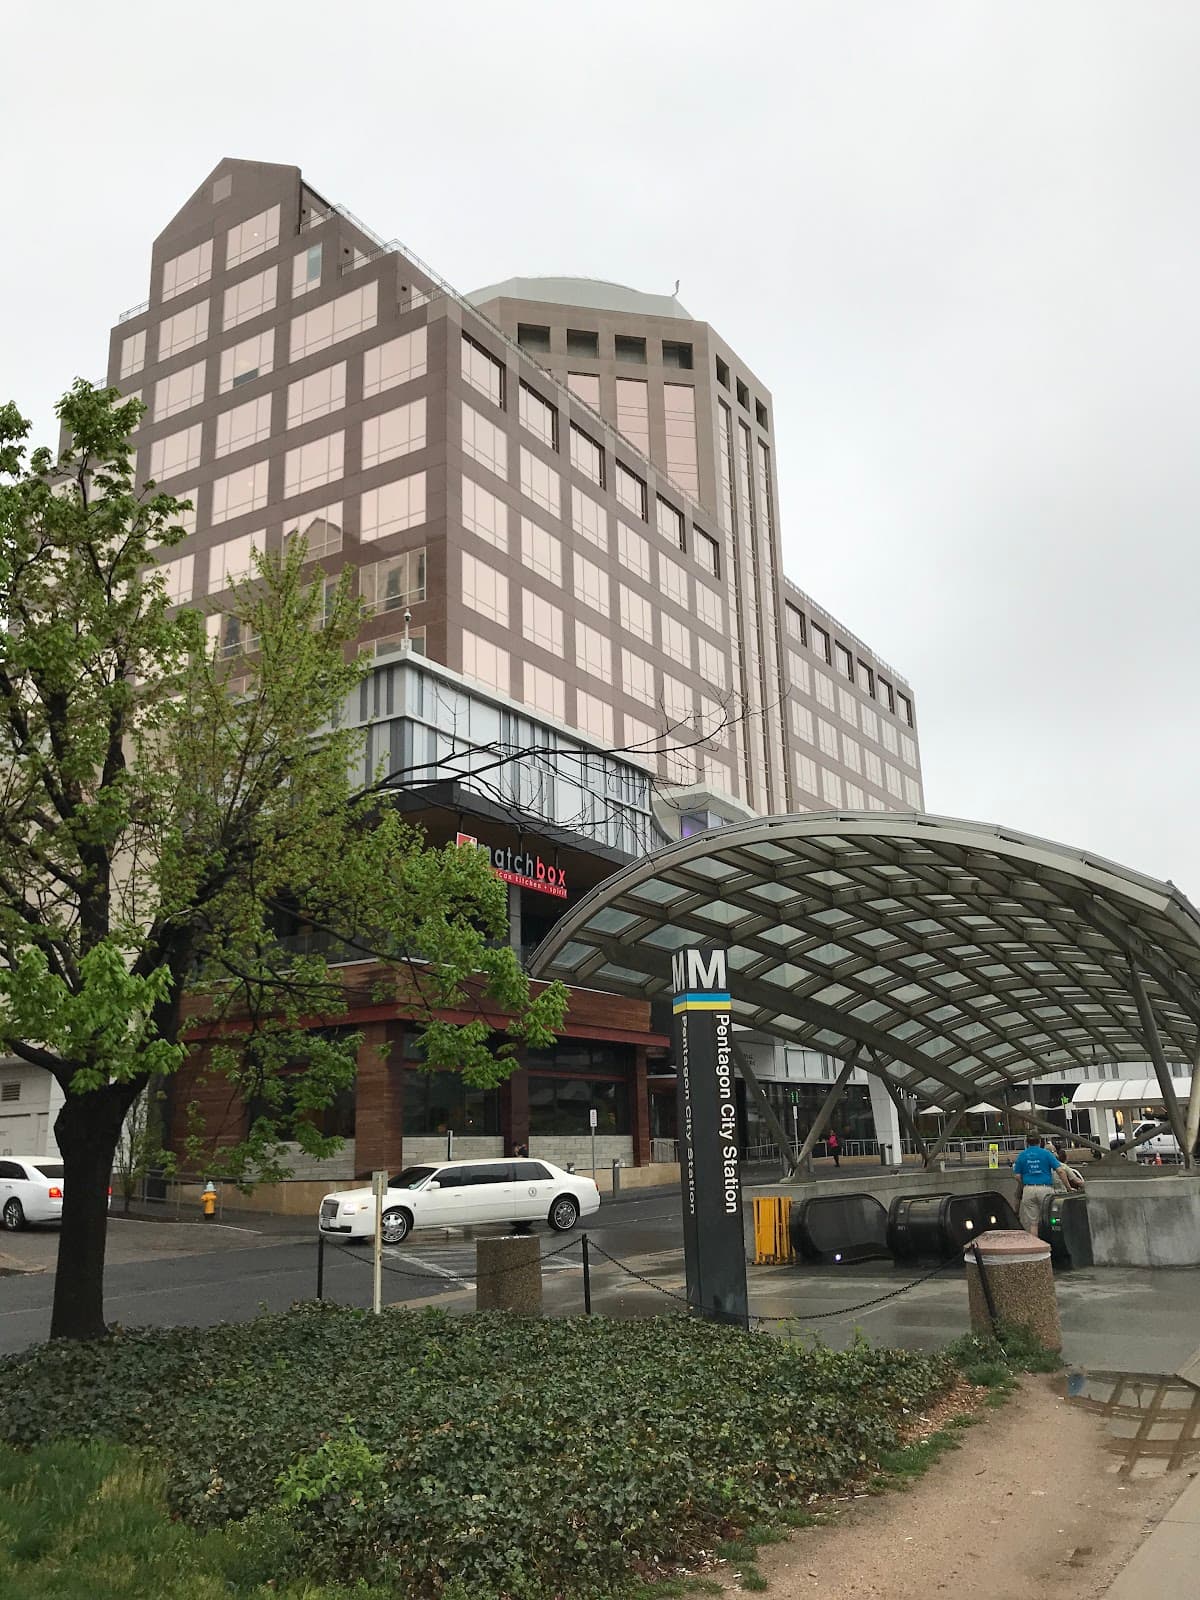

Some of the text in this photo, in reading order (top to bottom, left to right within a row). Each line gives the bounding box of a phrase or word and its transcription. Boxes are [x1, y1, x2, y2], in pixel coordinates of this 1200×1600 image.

[515, 874, 542, 889] kitchen
[672, 950, 685, 993] M
[687, 949, 727, 989] M
[682, 1015, 690, 1100] Pentagon
[687, 1147, 695, 1215] Station
[716, 1014, 739, 1213] Pentagon City Station
